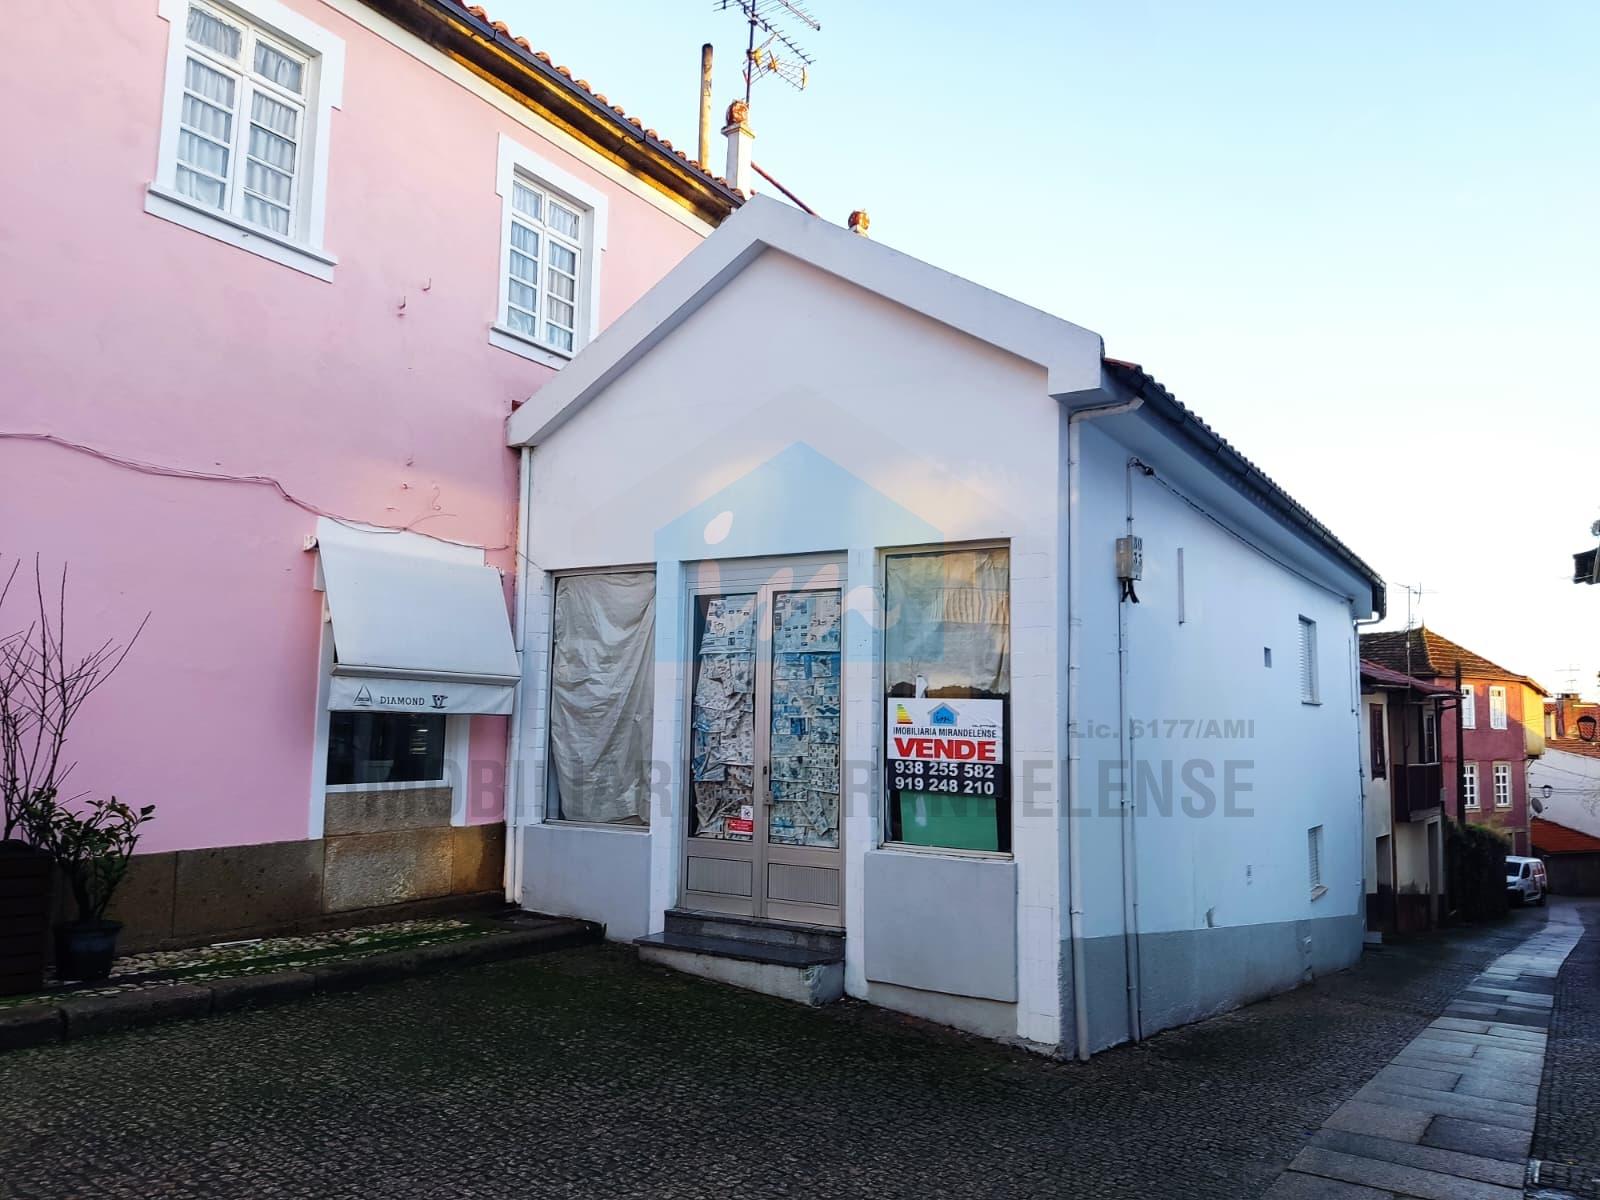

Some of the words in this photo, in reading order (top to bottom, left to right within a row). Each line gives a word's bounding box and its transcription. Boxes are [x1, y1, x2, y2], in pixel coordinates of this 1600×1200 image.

[380, 695, 425, 707] DIAMOND
[893, 726, 937, 736] IMOBILIARIA
[938, 727, 997, 738] MIRANDELENSE
[894, 737, 996, 761] VENDE
[894, 761, 924, 775] 938
[929, 762, 958, 776] 255
[963, 764, 995, 779] 582
[895, 777, 924, 790] 919
[928, 779, 958, 793] 248
[963, 780, 994, 795] 210
